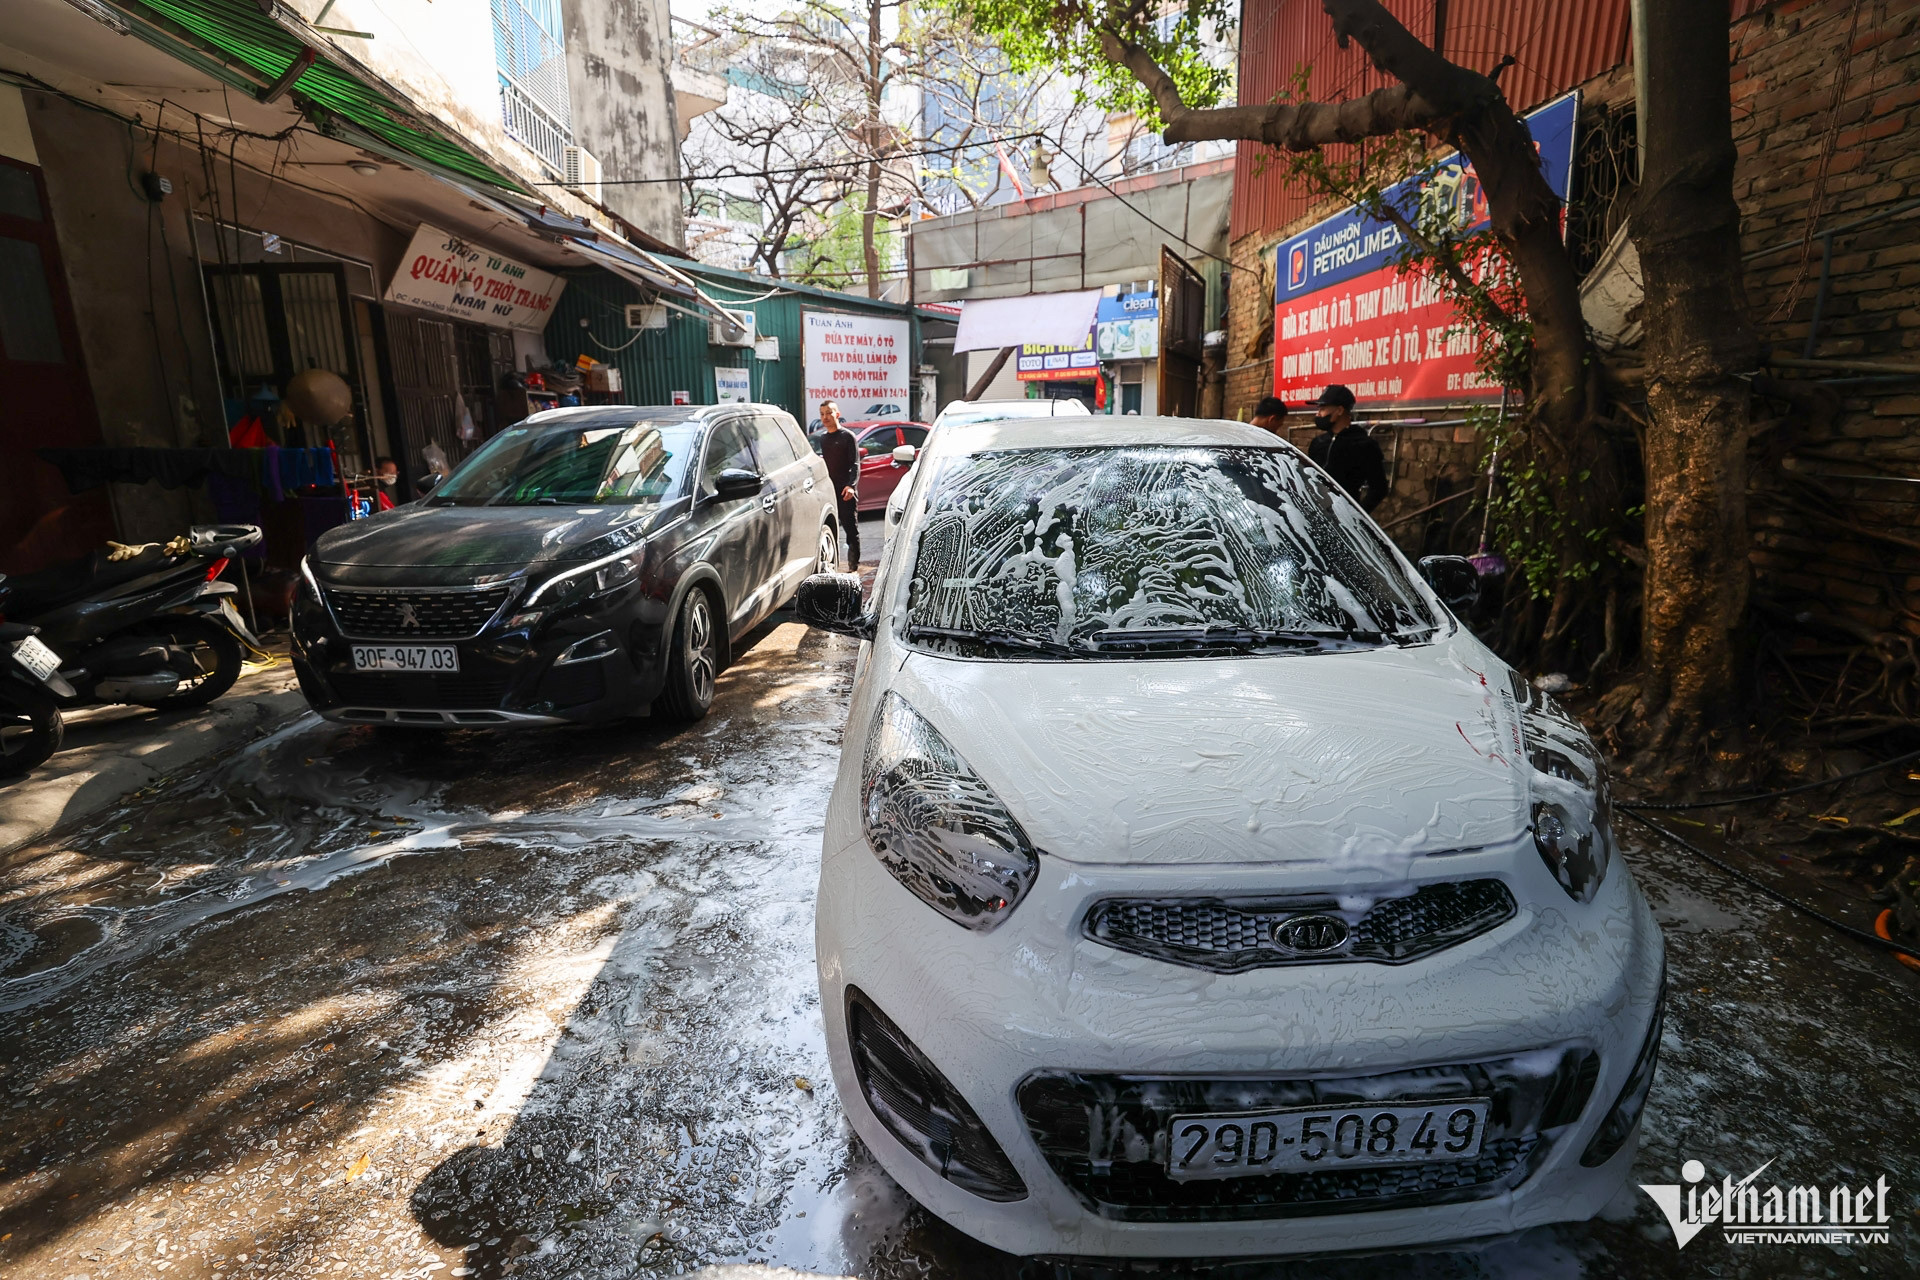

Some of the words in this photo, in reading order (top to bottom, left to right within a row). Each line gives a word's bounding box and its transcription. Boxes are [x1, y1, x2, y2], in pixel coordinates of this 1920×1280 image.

[1313, 224, 1402, 277] PETROLIMEX
[502, 263, 526, 279] ANH
[452, 293, 486, 311] NAM
[514, 287, 552, 312] TRANG
[1298, 310, 1308, 336] XE
[1330, 296, 1338, 329] Ô
[1355, 289, 1381, 322] THAY
[835, 319, 853, 329] ANH
[844, 334, 855, 346] XE
[877, 334, 882, 347] Ô
[884, 335, 894, 348] TÔ
[1374, 336, 1391, 367] XE
[1392, 328, 1402, 365] Ô
[1424, 326, 1444, 360] XE
[821, 352, 844, 363] THAY
[1021, 358, 1041, 368] TOTO
[872, 386, 888, 398] MÁY
[890, 388, 908, 398] 24/24
[355, 648, 454, 669] 30F-947.03
[1288, 925, 1339, 948] KIA
[1179, 1108, 1478, 1169] 29D-508.49
